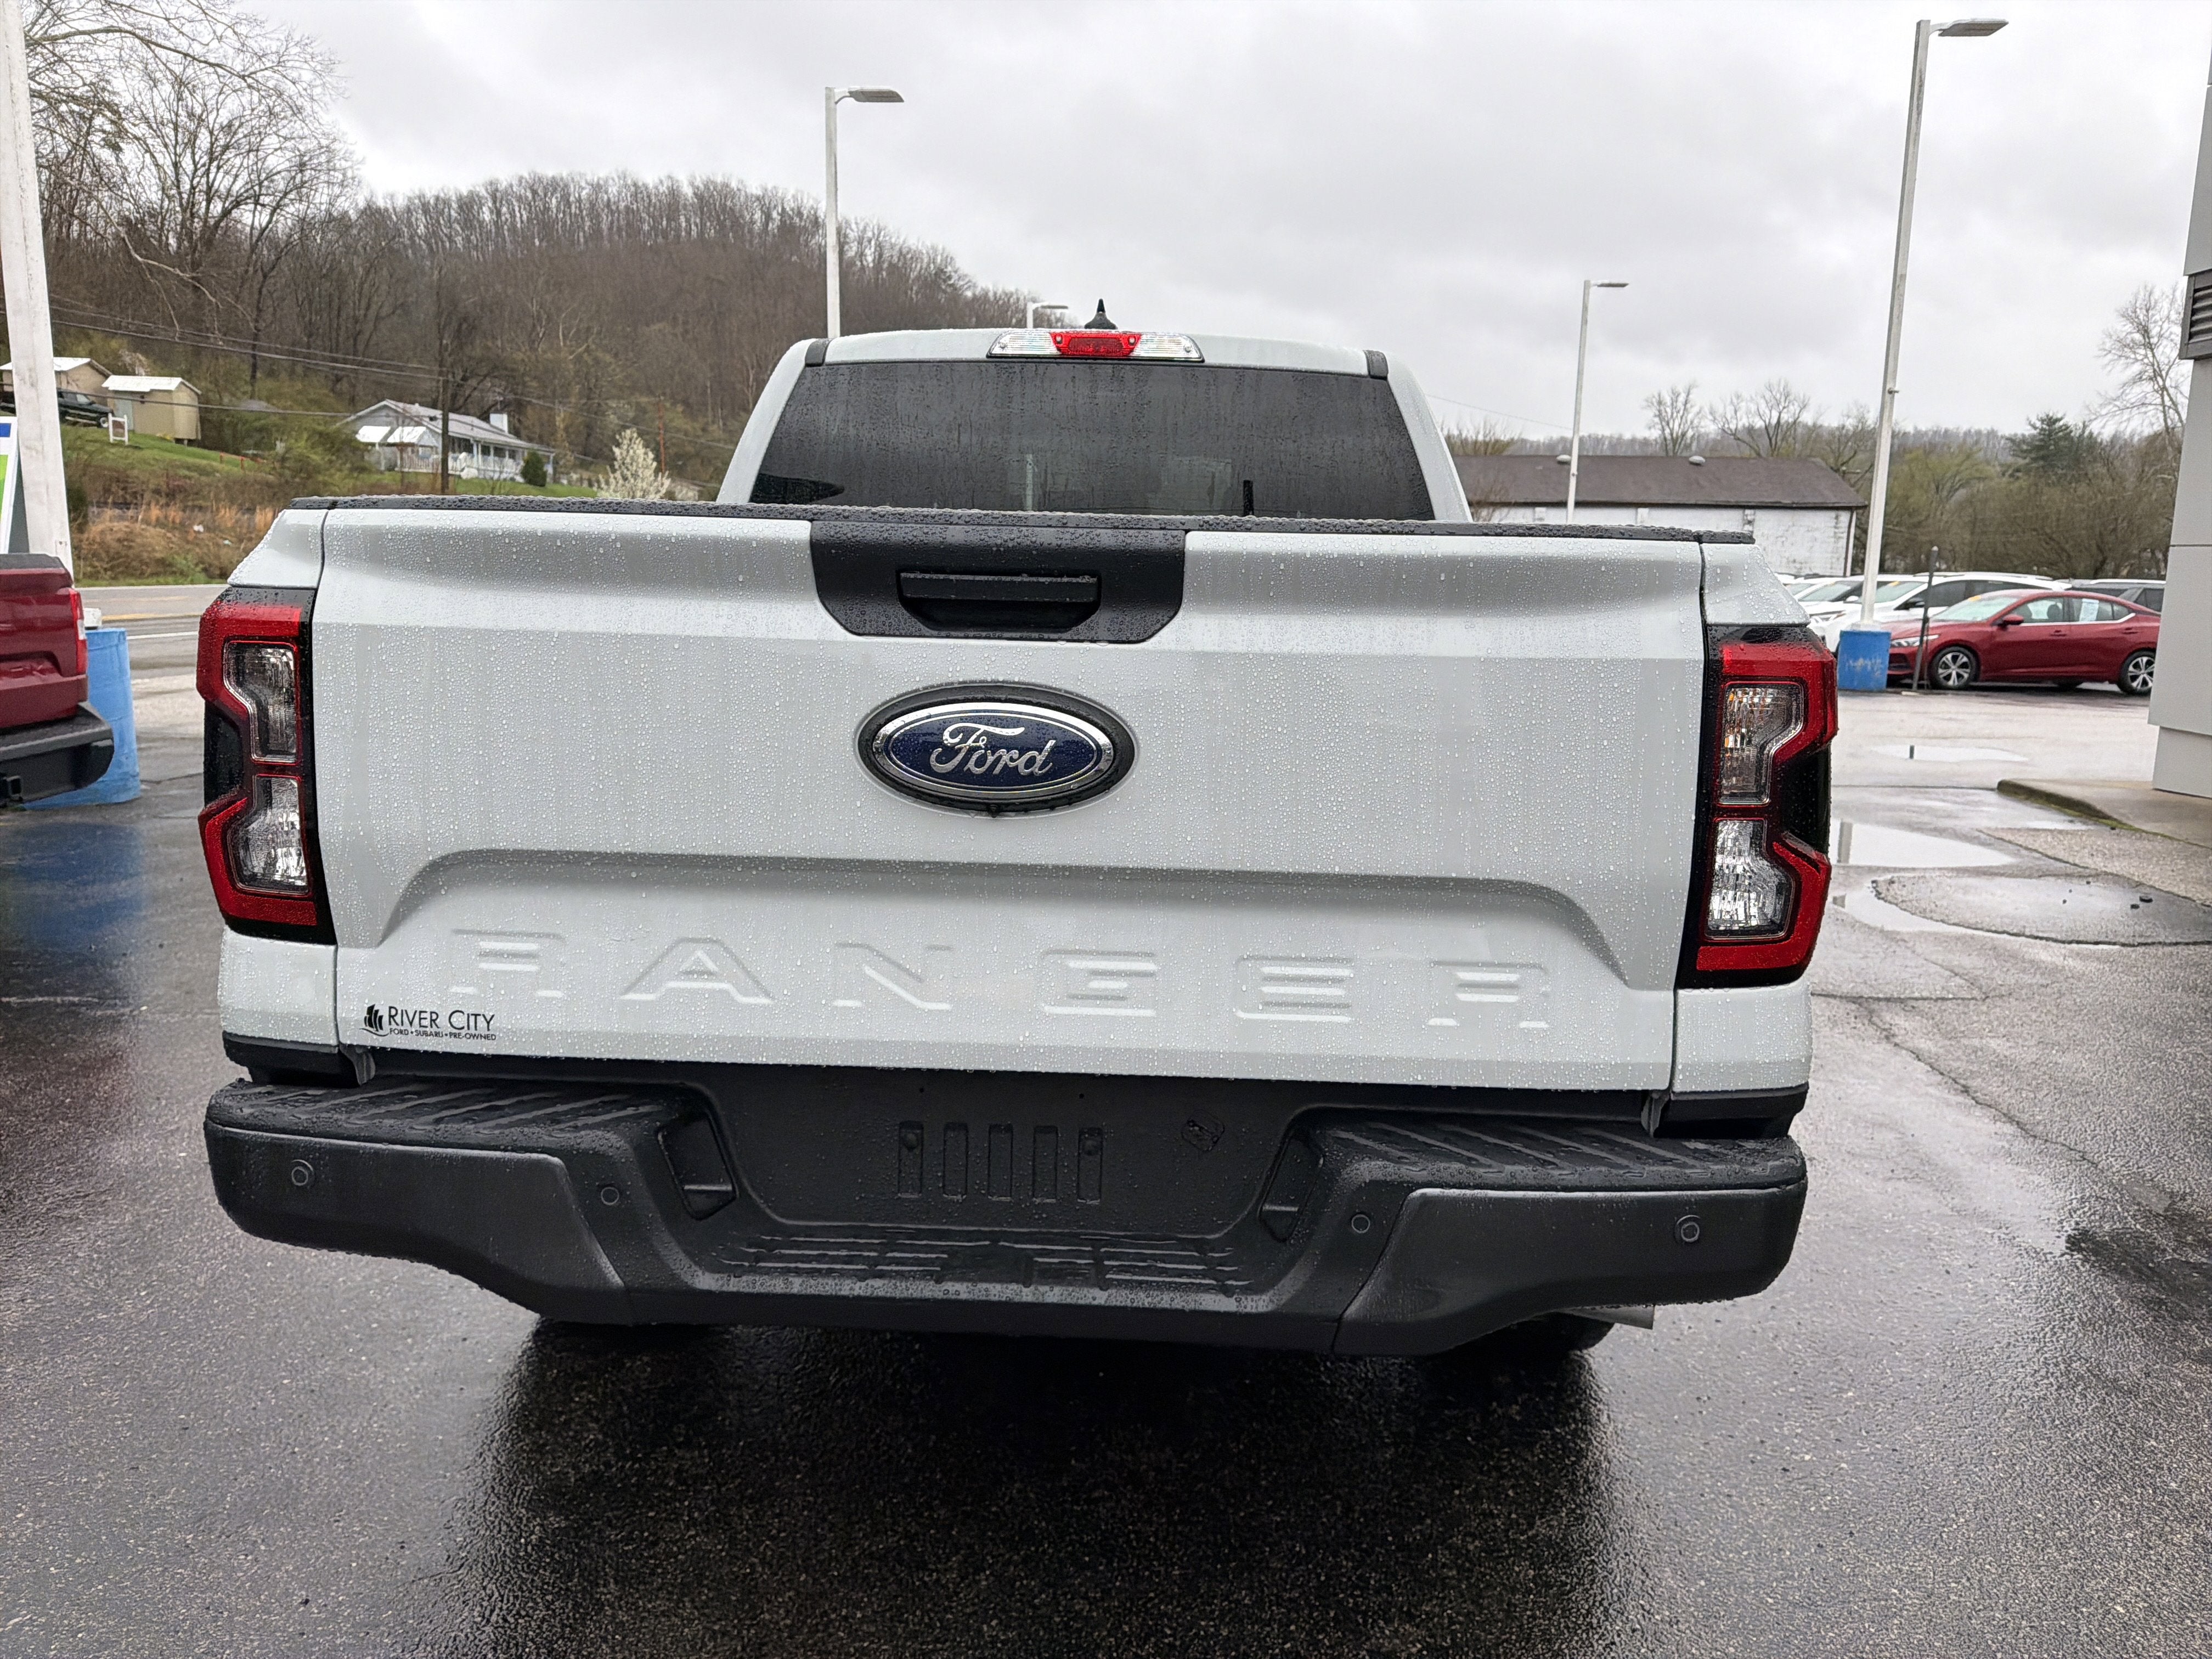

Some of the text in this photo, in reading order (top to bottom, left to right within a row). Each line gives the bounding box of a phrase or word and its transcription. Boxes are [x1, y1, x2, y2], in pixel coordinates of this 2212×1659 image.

[929, 722, 1054, 777] Ford
[450, 927, 1549, 1029] RANGER
[388, 1006, 495, 1031] RIVER CITY
[415, 1030, 443, 1038] SUBARU
[449, 1032, 496, 1041] PRE-OWNED
